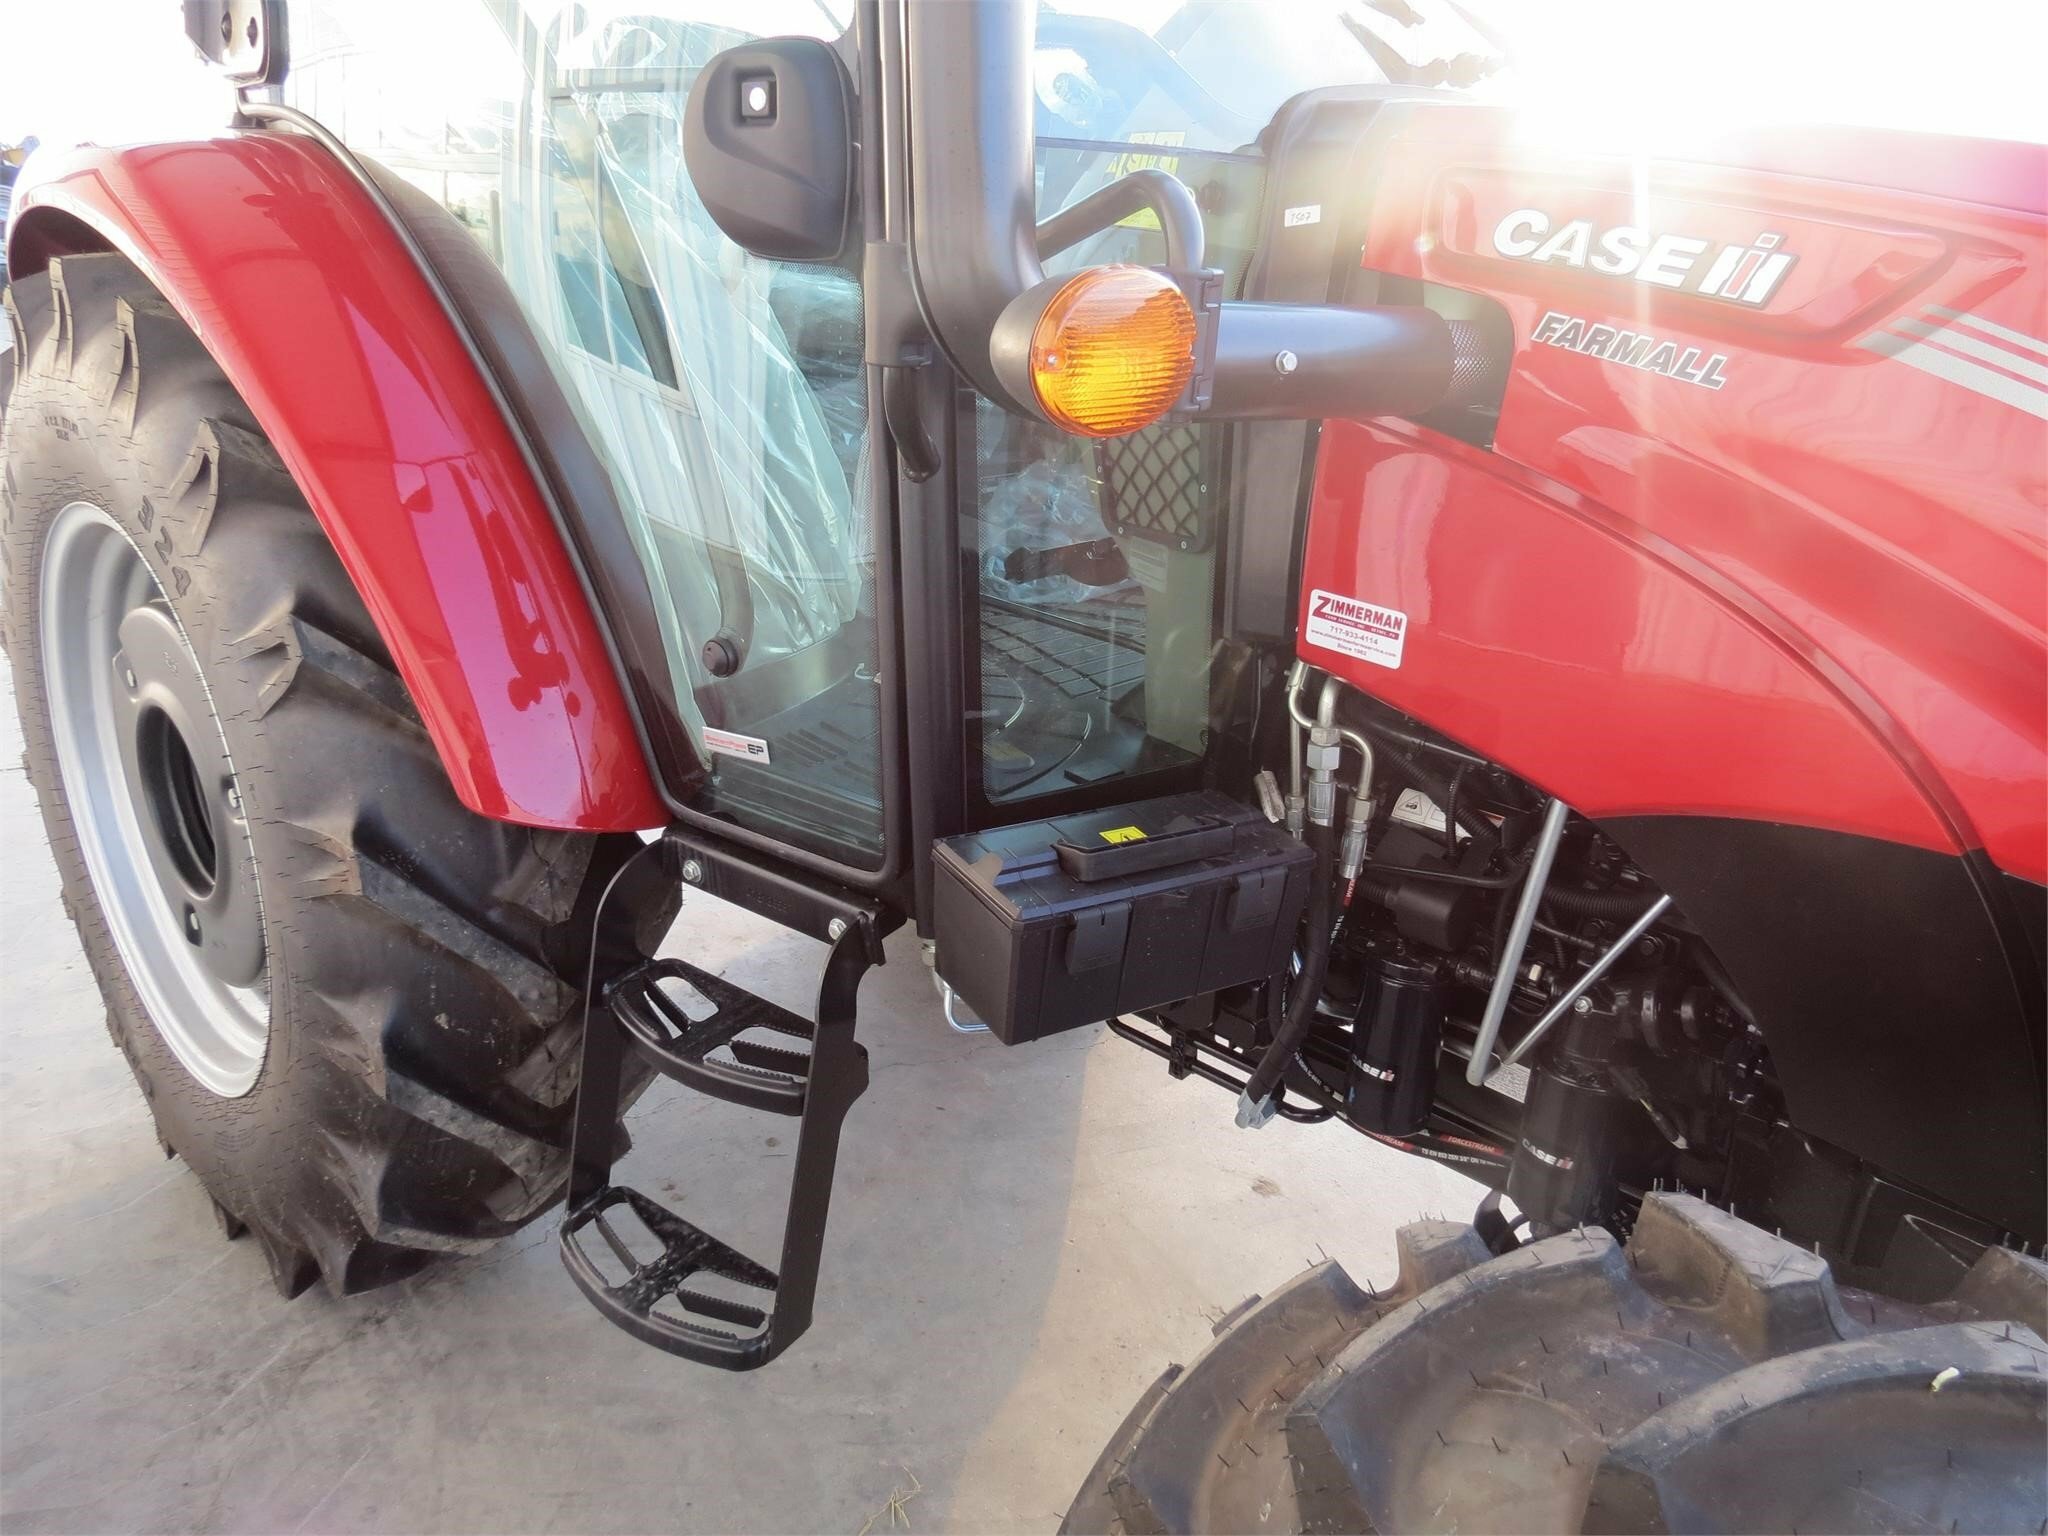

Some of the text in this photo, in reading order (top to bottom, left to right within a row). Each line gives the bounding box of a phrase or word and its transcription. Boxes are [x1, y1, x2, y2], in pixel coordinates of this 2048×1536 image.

[1492, 208, 1709, 289] CASE
[1531, 311, 1728, 390] FARMALL
[1312, 594, 1403, 632] ZIMMERMAN
[1330, 626, 1378, 645] 717-933-4114
[1352, 1053, 1380, 1078] CASE
[1447, 1136, 1496, 1153] FORCESTREAM
[1522, 1138, 1557, 1165] CASE
